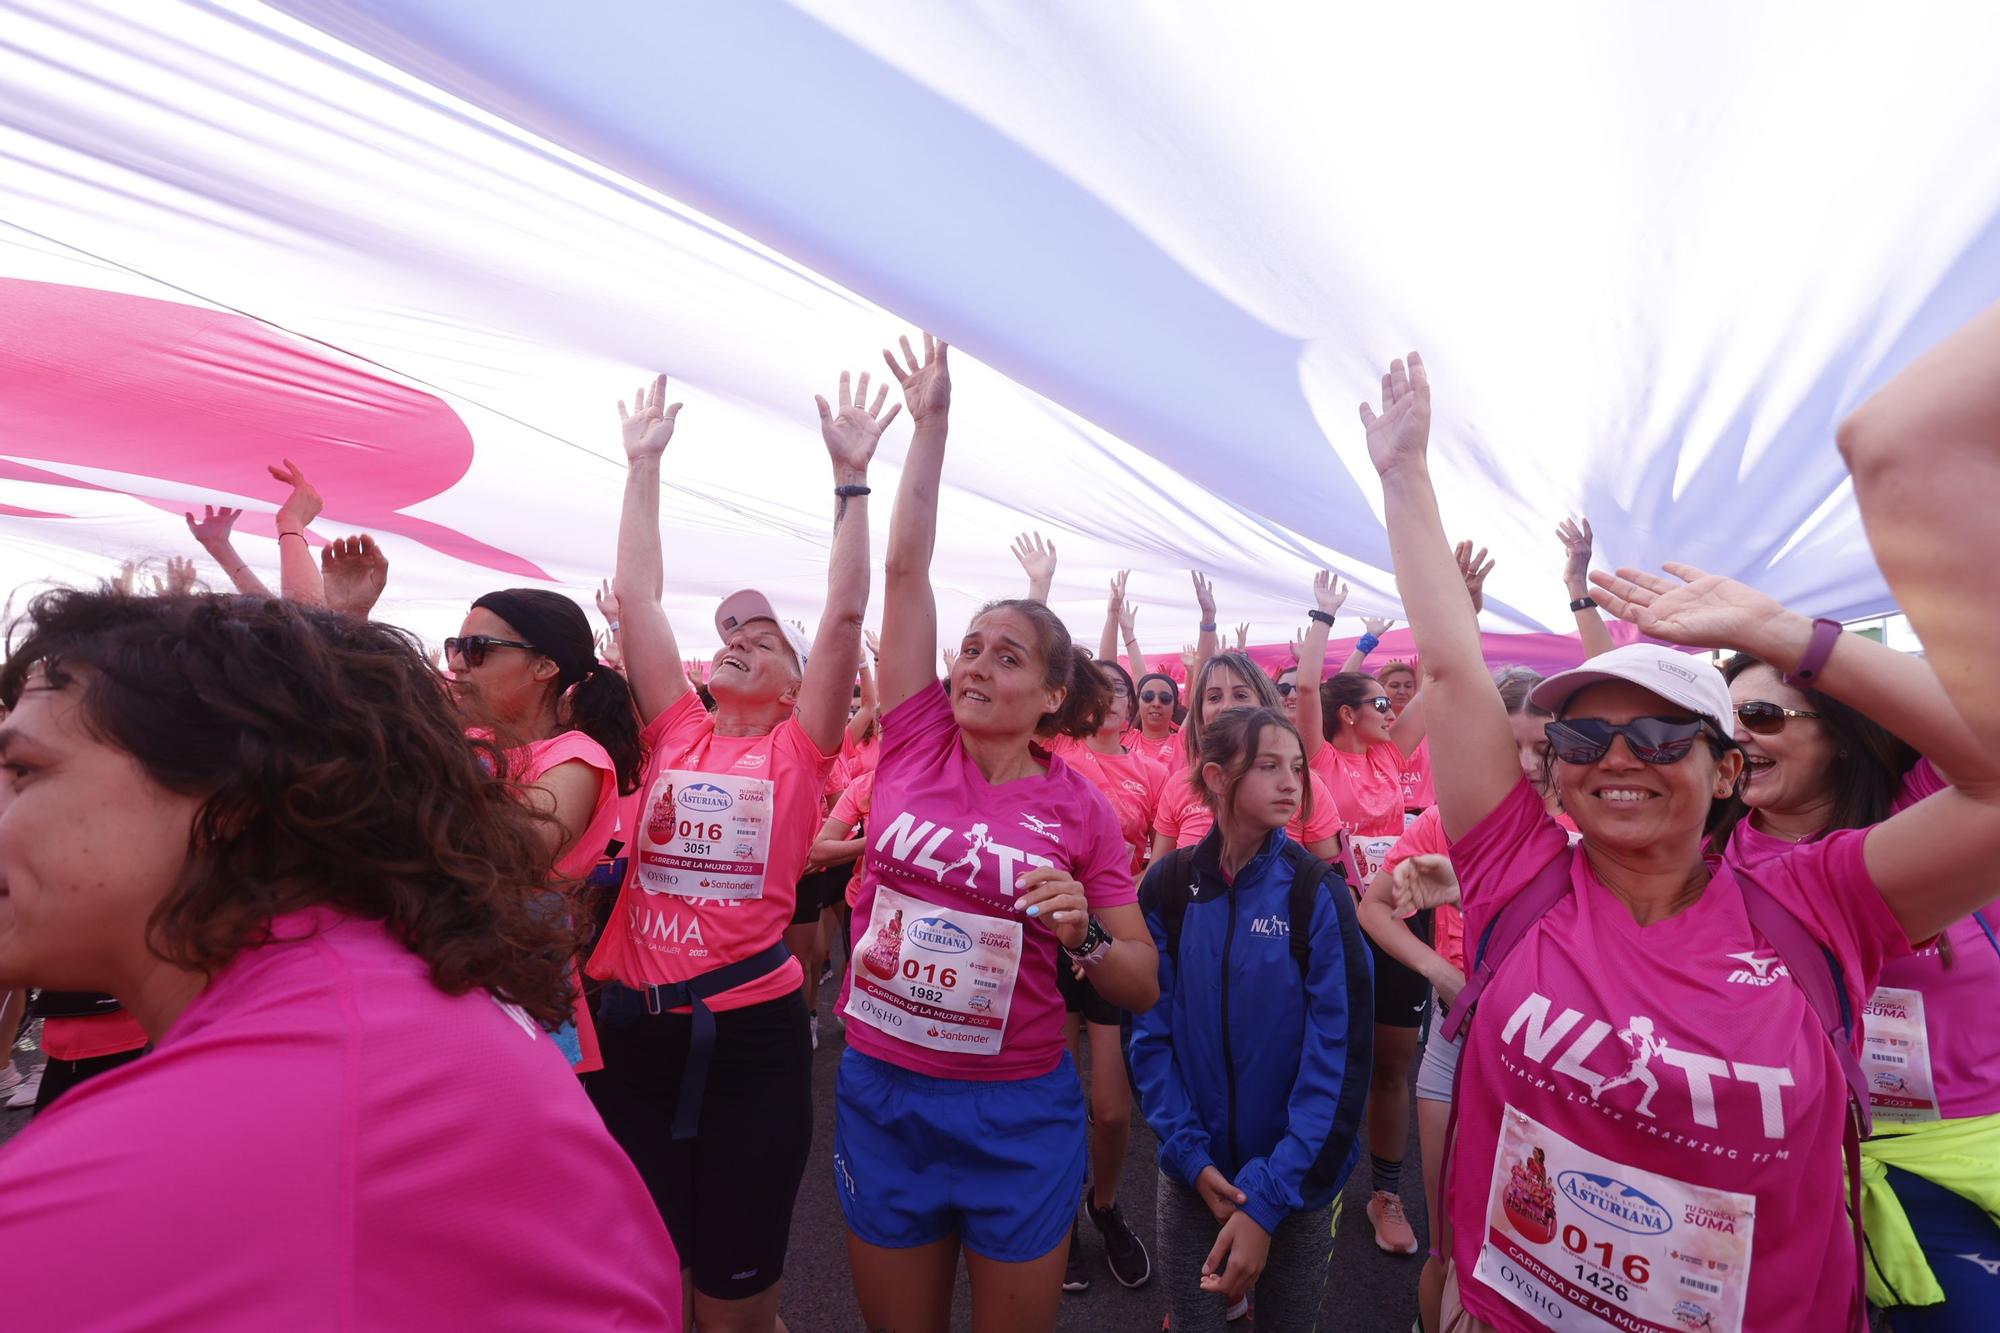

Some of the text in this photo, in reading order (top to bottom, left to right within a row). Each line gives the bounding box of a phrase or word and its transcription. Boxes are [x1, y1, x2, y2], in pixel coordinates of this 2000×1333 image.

[681, 792, 728, 807] ASTURIANA
[738, 793, 764, 802] SUMA
[678, 820, 723, 841] 016
[683, 842, 711, 855] 3051
[650, 856, 680, 866] CARRERA
[704, 862, 732, 872] MUJER
[734, 864, 753, 873] 2023
[647, 871, 678, 885] OYSHO
[711, 880, 754, 891] Santander
[629, 903, 705, 946] SUMA
[910, 924, 966, 950] ASTURIANA
[979, 936, 1010, 950] SUMA
[902, 959, 957, 989] 016
[909, 985, 943, 1004] 1982
[861, 1000, 903, 1028] OYSHO
[867, 985, 990, 1026] CARRERA DE LA MUJER 2023
[1864, 1006, 1907, 1019] SUMA
[1874, 1002, 1906, 1010] DORSAL
[939, 1029, 990, 1045] Santander
[1636, 1121, 1738, 1161] TRAINING
[1565, 1177, 1662, 1230] ASTURIANA
[1684, 1205, 1696, 1213] TU
[1684, 1213, 1735, 1236] SUMA
[1563, 1224, 1650, 1285] 016
[1500, 1265, 1563, 1320] OYSHO
[1509, 1247, 1565, 1294] CARRERA
[1568, 1289, 1589, 1306] DE
[1591, 1301, 1611, 1318] LA
[1575, 1264, 1629, 1303] 1426
